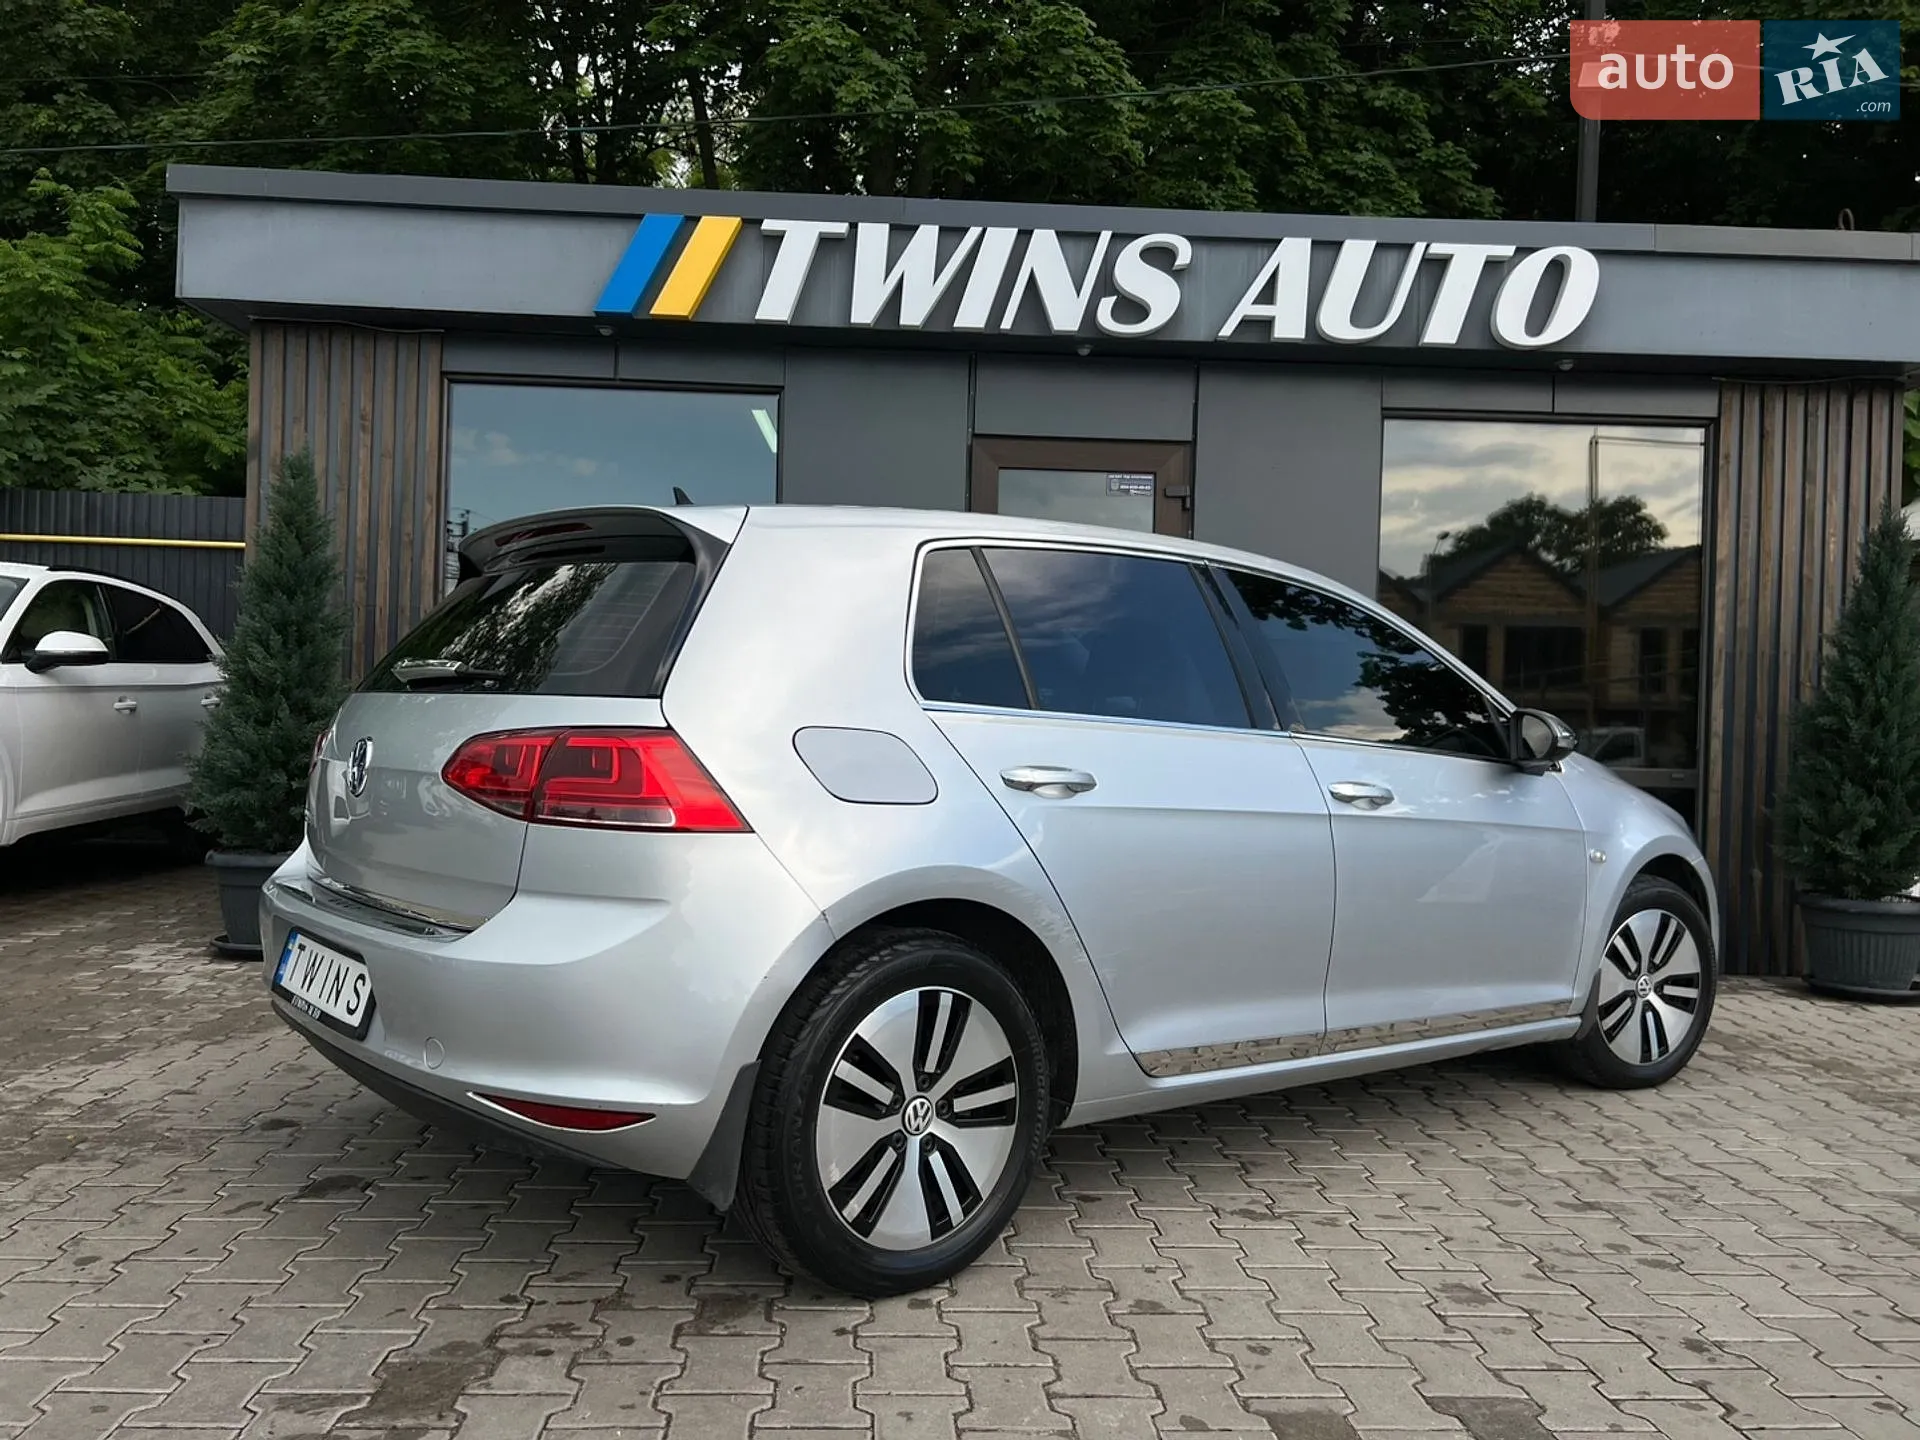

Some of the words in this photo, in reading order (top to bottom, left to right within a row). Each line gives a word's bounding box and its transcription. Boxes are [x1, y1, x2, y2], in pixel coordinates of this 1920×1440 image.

[754, 219, 1192, 337] TWINS
[1217, 237, 1600, 349] AUTO
[289, 943, 366, 1016] TWINS
